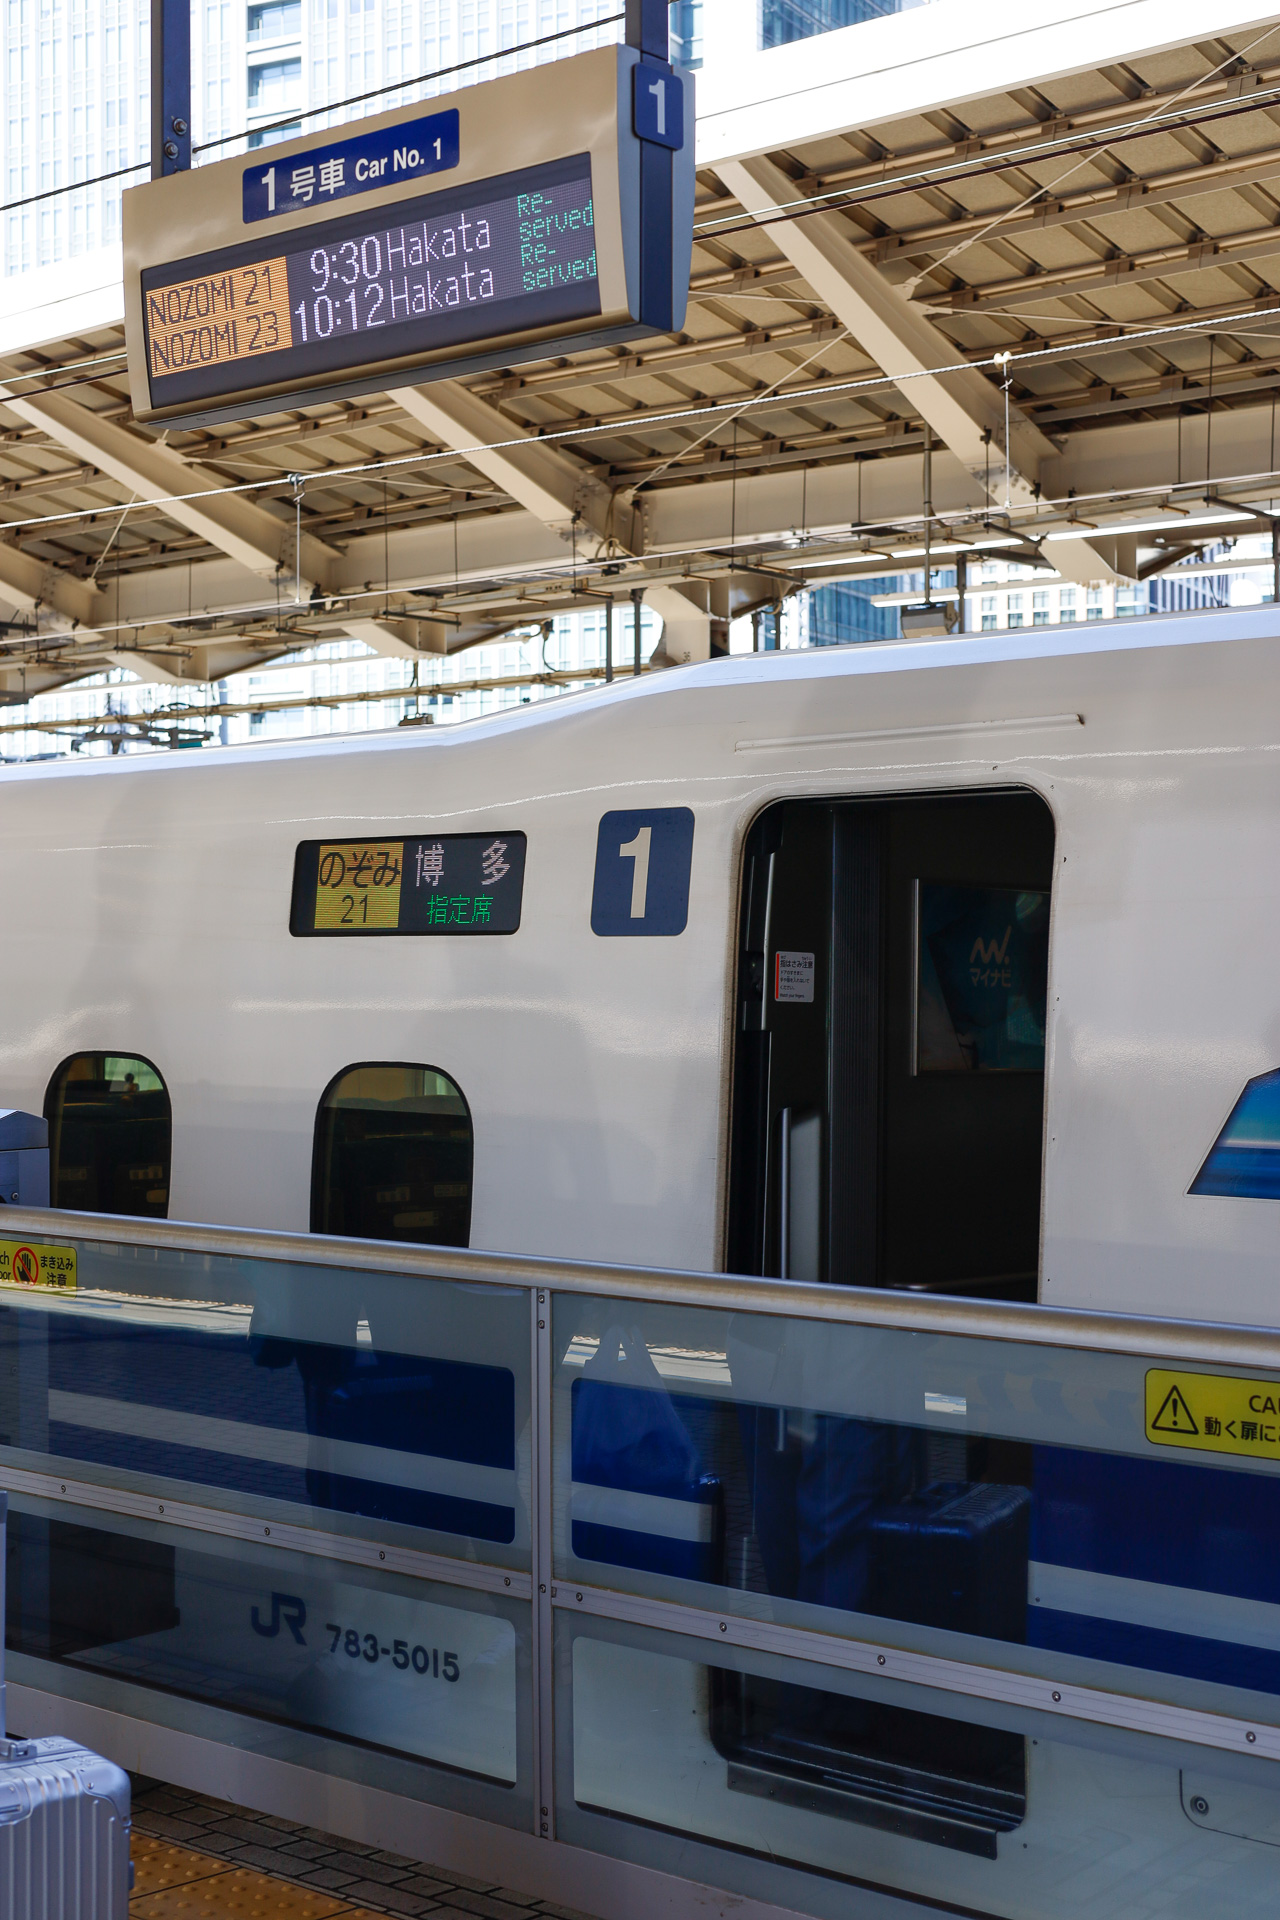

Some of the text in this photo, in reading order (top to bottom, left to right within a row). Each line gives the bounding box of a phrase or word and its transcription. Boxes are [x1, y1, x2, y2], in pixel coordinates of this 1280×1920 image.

[649, 79, 666, 135] 1
[261, 137, 442, 211] 1 号車 Car No. 1
[517, 193, 553, 218] Re-
[519, 199, 594, 241] served
[149, 213, 491, 329] NOZOMI 21 9:30 Hakata
[521, 243, 556, 267] Re-
[523, 249, 597, 291] served
[152, 261, 494, 372] NOZOMI 23 10:12 Hakata
[319, 850, 401, 888] のぞみ
[619, 826, 652, 919] 1
[340, 893, 494, 925] 21 指定席
[969, 967, 1012, 988] マイナビ
[40, 1255, 74, 1272] まき込み
[1248, 1394, 1280, 1416] CA
[1204, 1416, 1280, 1443] 動く扉に
[251, 1592, 460, 1683] JR 783-5015
